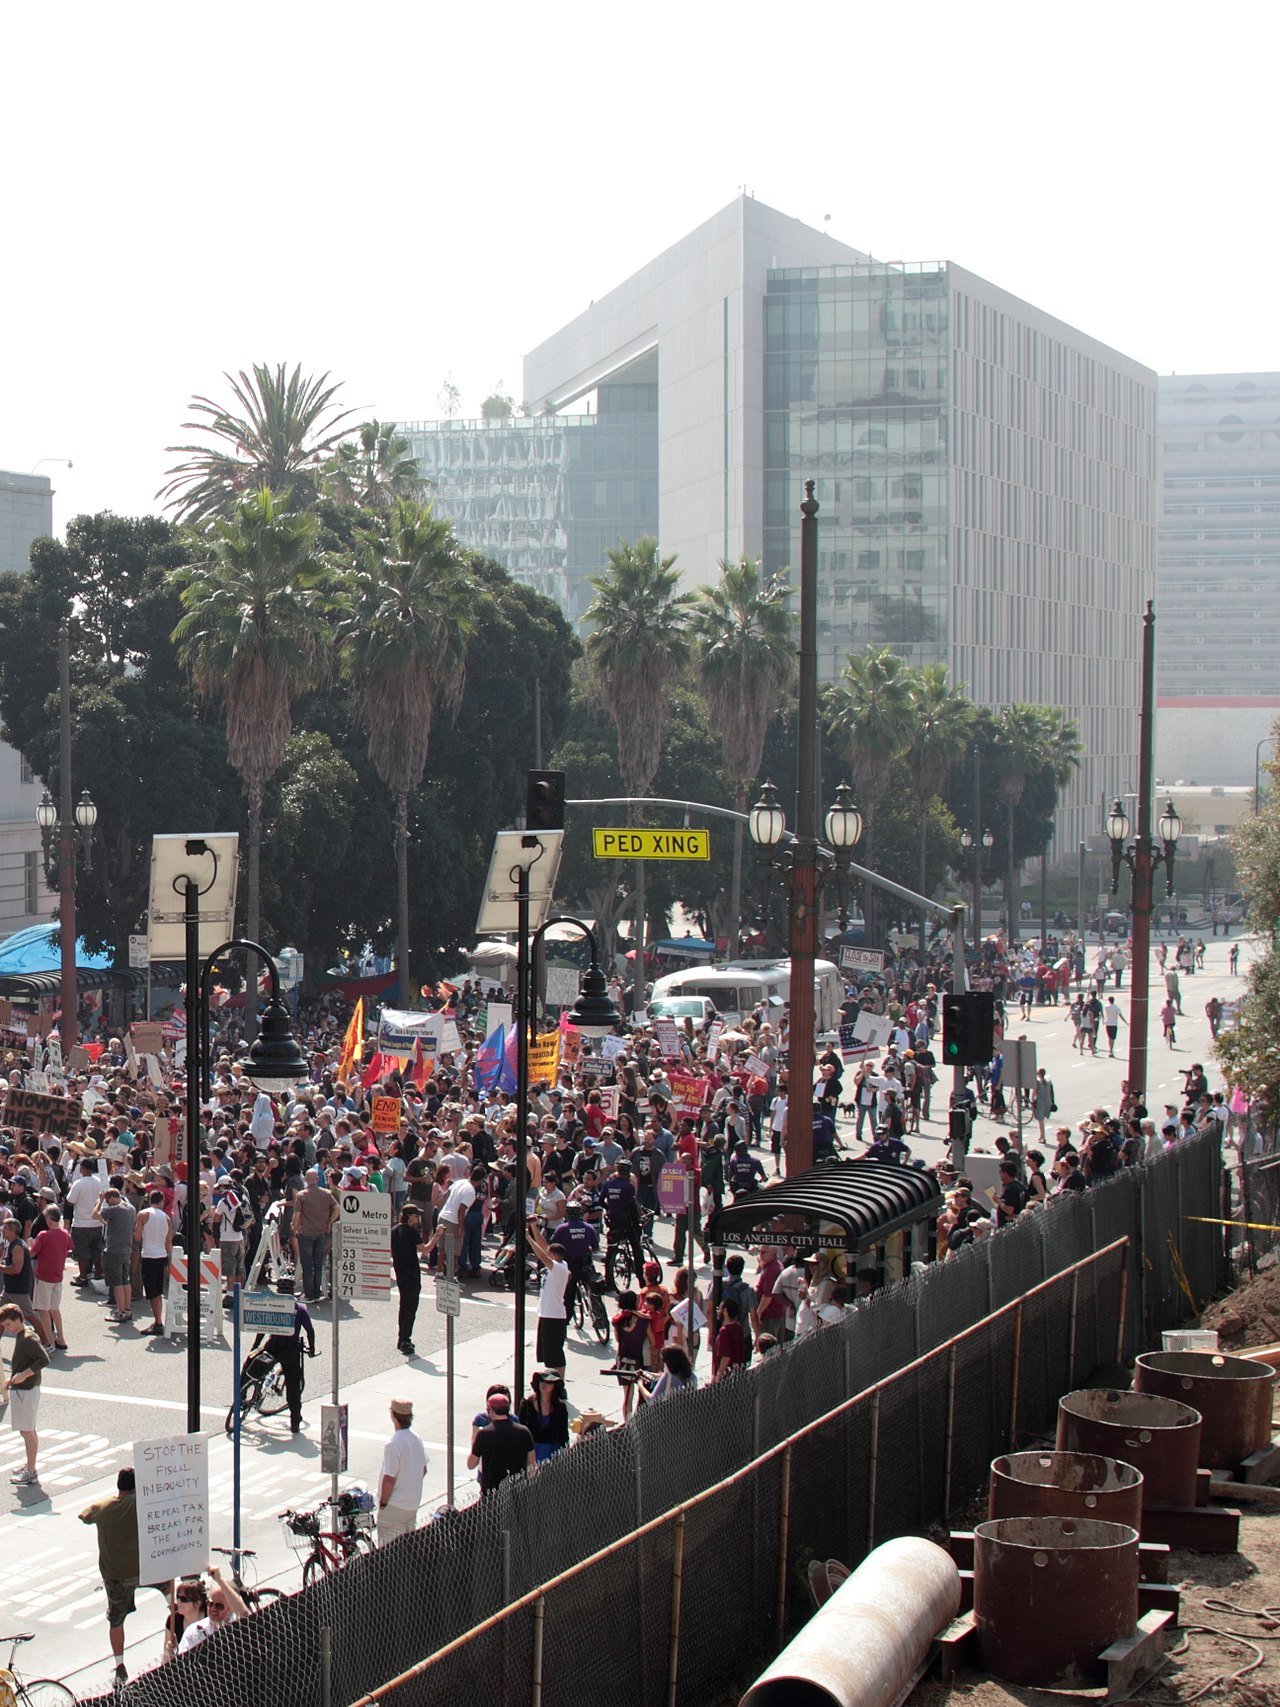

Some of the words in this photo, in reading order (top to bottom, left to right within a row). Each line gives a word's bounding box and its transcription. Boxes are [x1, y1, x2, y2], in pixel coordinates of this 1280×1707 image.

[604, 835, 642, 852] PED
[653, 835, 699, 854] XING
[845, 950, 863, 961] CLOSE
[12, 1091, 50, 1109] NOW
[52, 1101, 80, 1118] IS
[375, 1100, 397, 1111] END
[2, 1108, 36, 1129] THE
[38, 1112, 80, 1136] TIME
[176, 1124, 185, 1161] BROS
[362, 1211, 388, 1219] Metro
[343, 1226, 362, 1234] Silver
[364, 1227, 379, 1235] Line
[723, 1233, 740, 1242] LOS
[744, 1235, 788, 1244] ANGELES
[791, 1236, 814, 1246] CITY
[818, 1238, 846, 1247] HALL
[342, 1249, 356, 1259] 33
[342, 1261, 355, 1271] 68
[342, 1274, 356, 1284] 70
[342, 1286, 354, 1296] 71
[245, 1311, 291, 1326] WESTBOUND
[143, 1445, 177, 1461] STOP
[178, 1443, 202, 1455] THE
[156, 1464, 191, 1477] FISCAL
[143, 1477, 199, 1497] INEQUALITY
[147, 1507, 180, 1520] REPEAL
[181, 1503, 204, 1513] TAX
[147, 1520, 181, 1534] BREAKS
[185, 1516, 204, 1527] FOR
[152, 1534, 170, 1545] THE
[150, 1540, 203, 1559] CORPORATIONS
